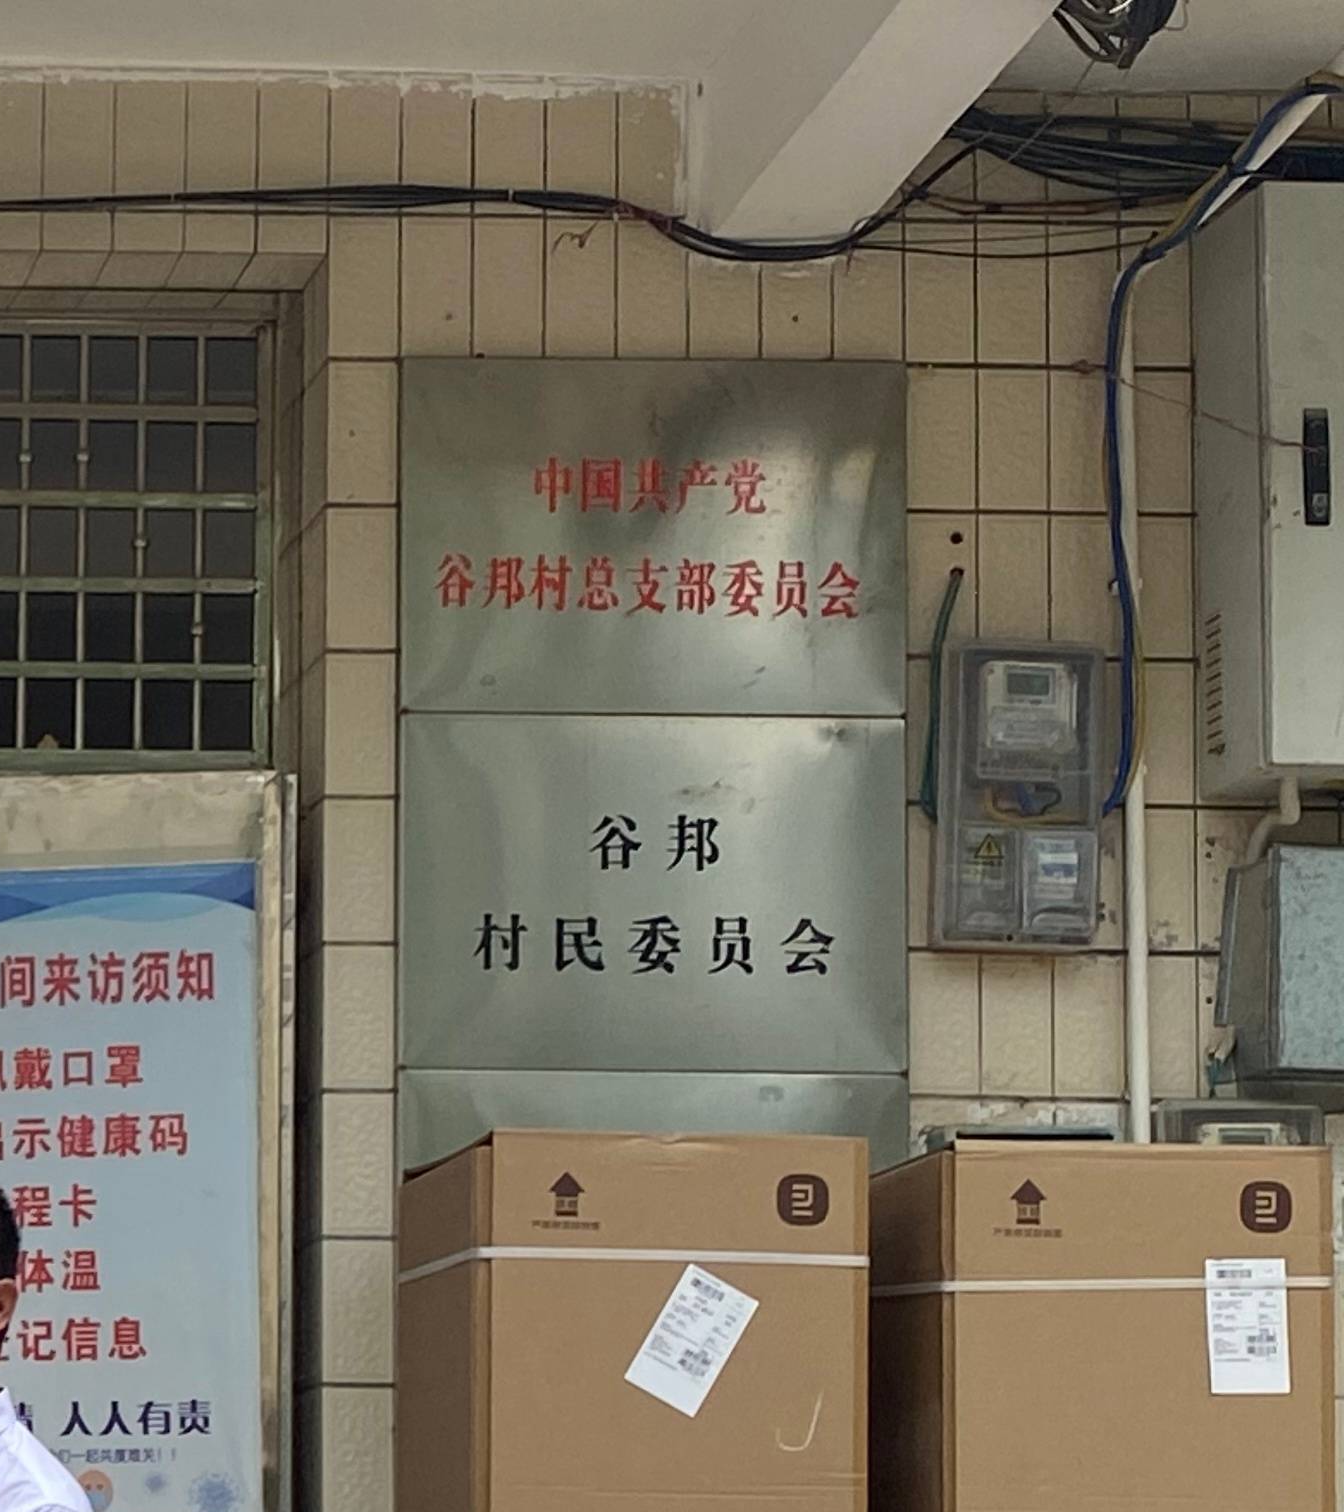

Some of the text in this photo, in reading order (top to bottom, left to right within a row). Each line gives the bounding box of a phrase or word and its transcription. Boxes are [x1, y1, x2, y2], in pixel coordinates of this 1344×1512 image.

[533, 457, 766, 515] 中国共产党
[434, 553, 861, 619] 谷邦村总支部委员会
[589, 814, 720, 872] 谷邦
[473, 913, 836, 975] 村民委员会
[61, 1400, 211, 1436] 人人有责
